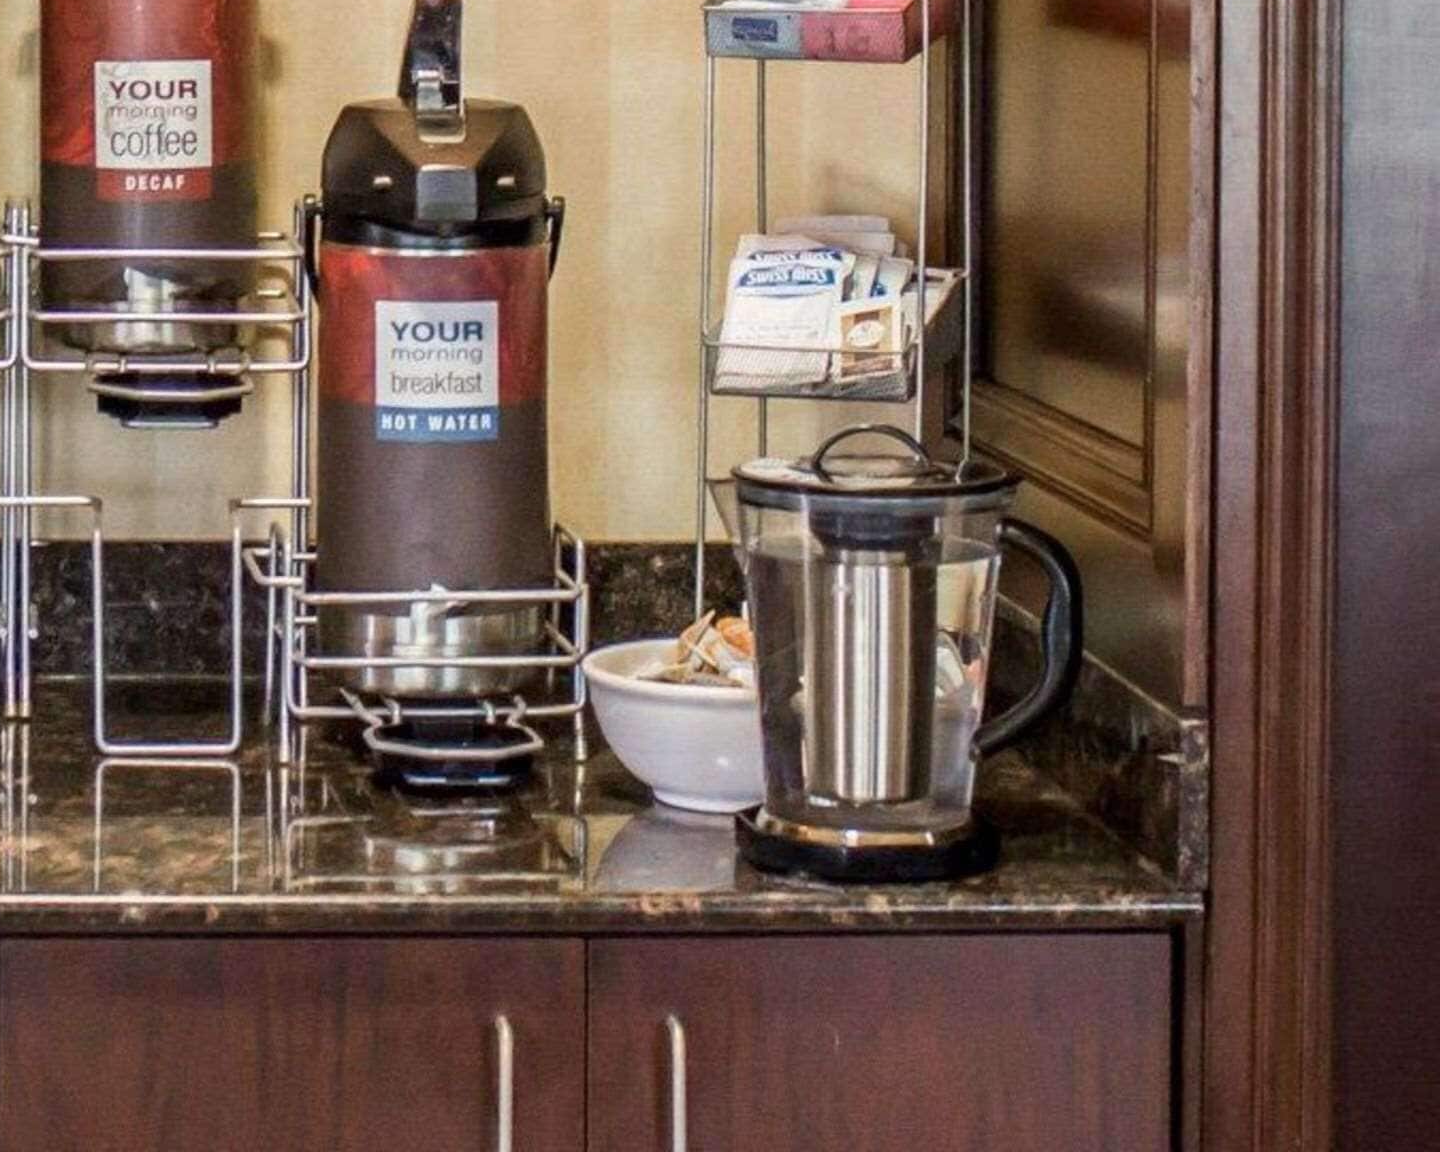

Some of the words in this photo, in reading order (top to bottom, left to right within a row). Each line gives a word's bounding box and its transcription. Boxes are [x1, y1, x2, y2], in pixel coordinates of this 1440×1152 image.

[109, 79, 198, 100] YOUR
[109, 104, 198, 122] morning
[110, 122, 198, 158] coffee
[124, 174, 186, 191] DECAF
[390, 320, 484, 343] YOUR
[390, 347, 484, 366] morning
[390, 370, 483, 395] breakfast
[380, 413, 418, 431] HOT
[427, 413, 493, 431] WATER
